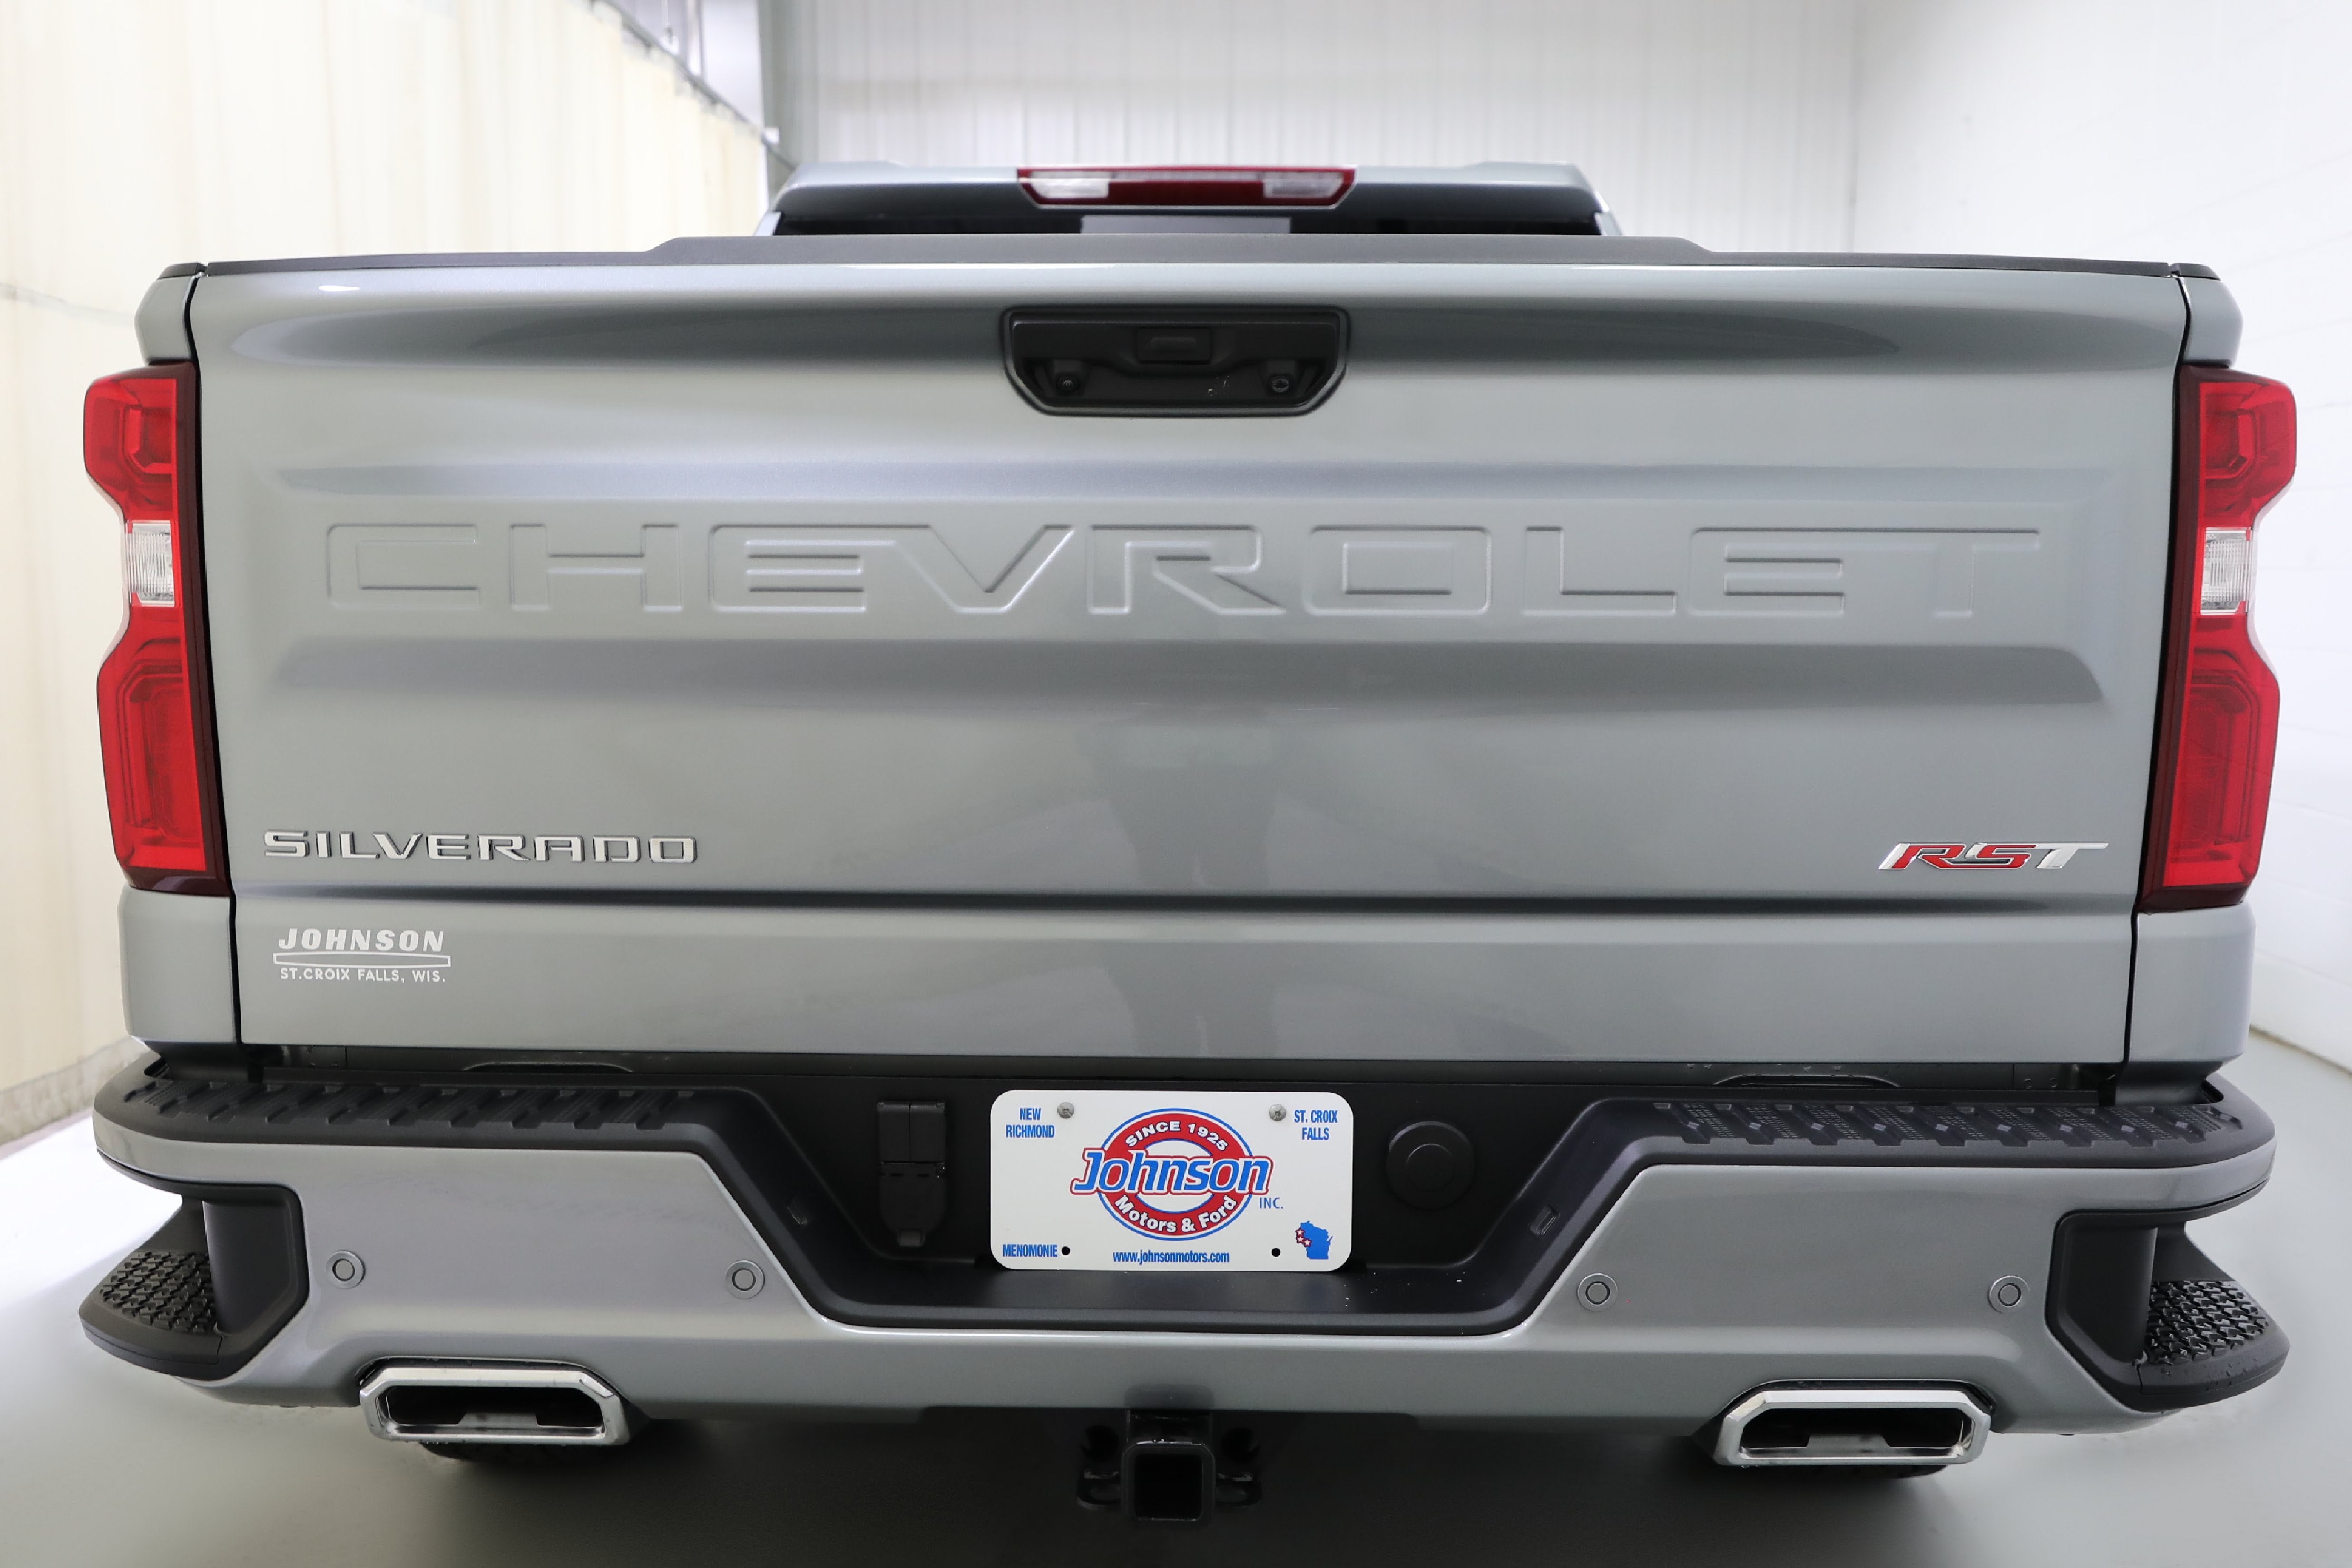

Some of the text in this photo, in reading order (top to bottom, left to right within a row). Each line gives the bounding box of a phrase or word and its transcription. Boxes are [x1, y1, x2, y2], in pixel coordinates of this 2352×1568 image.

[327, 522, 2040, 619] CHEVROLET
[263, 830, 698, 864] SILVERADO
[1879, 842, 2109, 870] RST
[278, 928, 444, 952] JOHNSON
[357, 969, 405, 983] FALLS,
[411, 969, 446, 983] WIS.
[1019, 1108, 1041, 1121] NEW
[1293, 1110, 1338, 1124] ST. CROIX
[1006, 1124, 1055, 1139] RICHMOND
[1125, 1121, 1228, 1151] SINCE 1925
[1302, 1127, 1330, 1141] FALLS
[1072, 1149, 1272, 1194] Johnson
[1259, 1197, 1284, 1210] INC.
[1115, 1195, 1237, 1234] Motors & Ford
[1002, 1244, 1058, 1258] MENOMONIE
[1113, 1250, 1230, 1264] www.johnsonmotors.com
